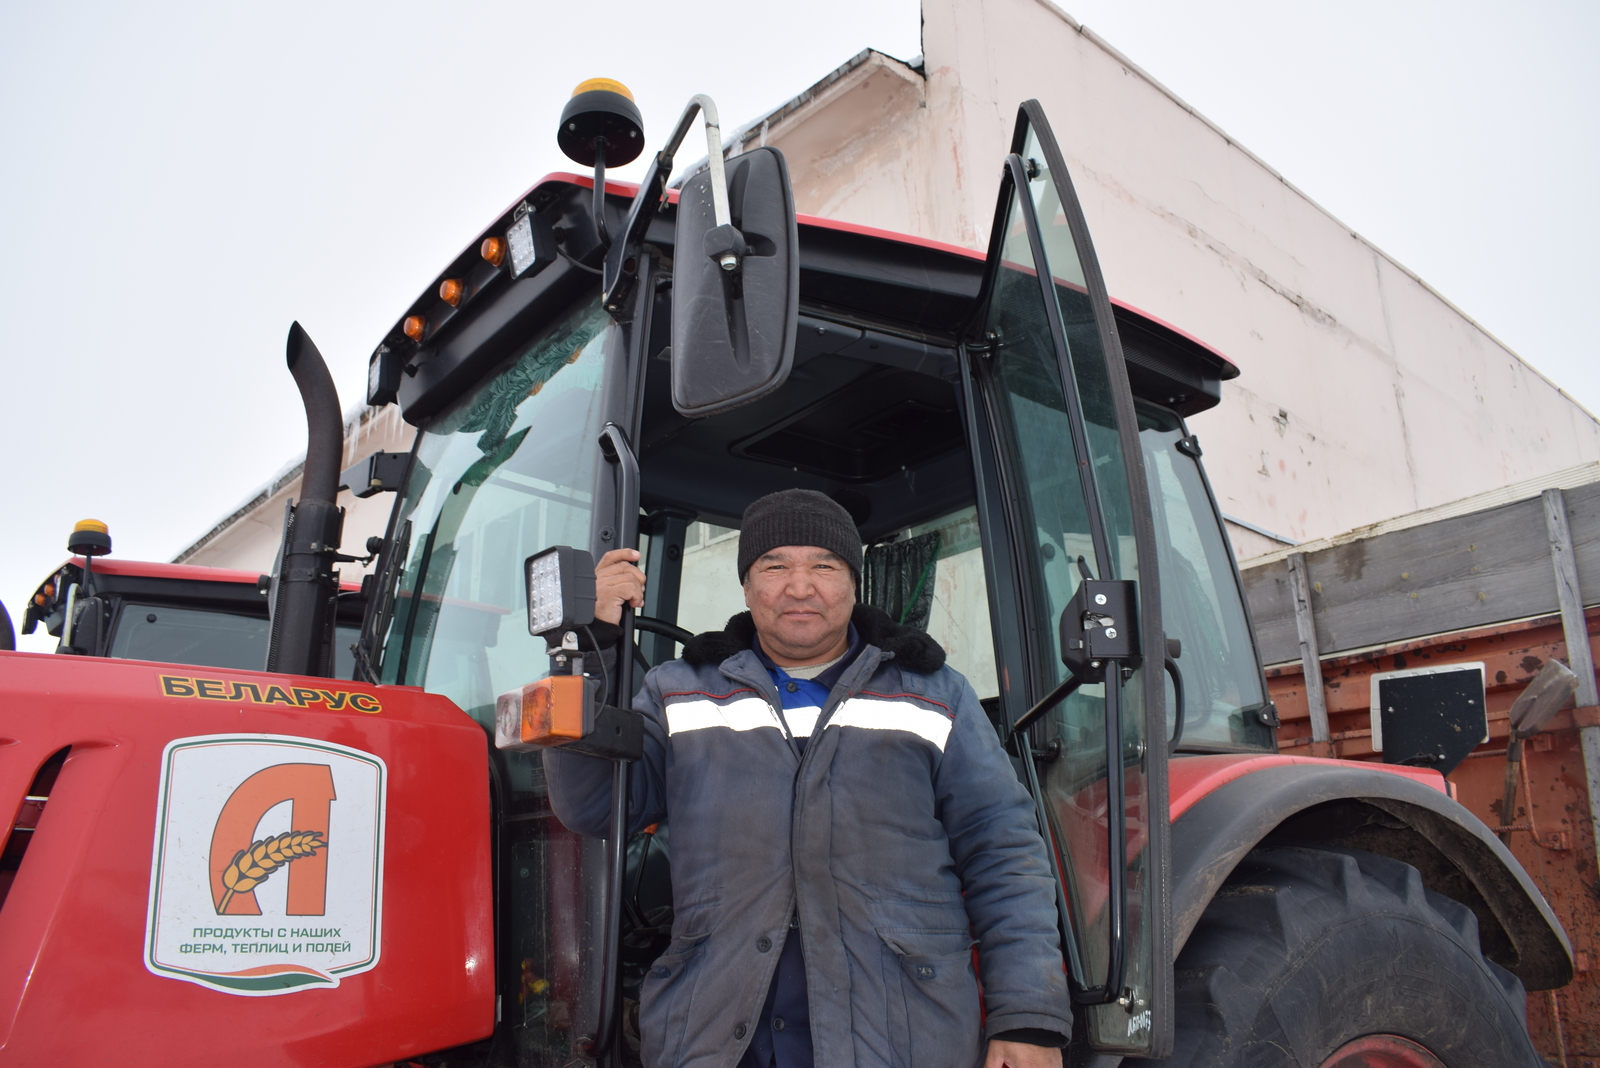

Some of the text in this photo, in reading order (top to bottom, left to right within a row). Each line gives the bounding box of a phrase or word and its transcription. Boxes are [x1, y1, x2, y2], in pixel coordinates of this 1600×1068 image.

[158, 674, 382, 714] БЕЛАРУС
[192, 927, 342, 939] ПРОДУКТЫ С НАШИХ
[179, 940, 351, 955] ФЕРМ, ТЕПЛИЦ И ПОЛЕЙ
